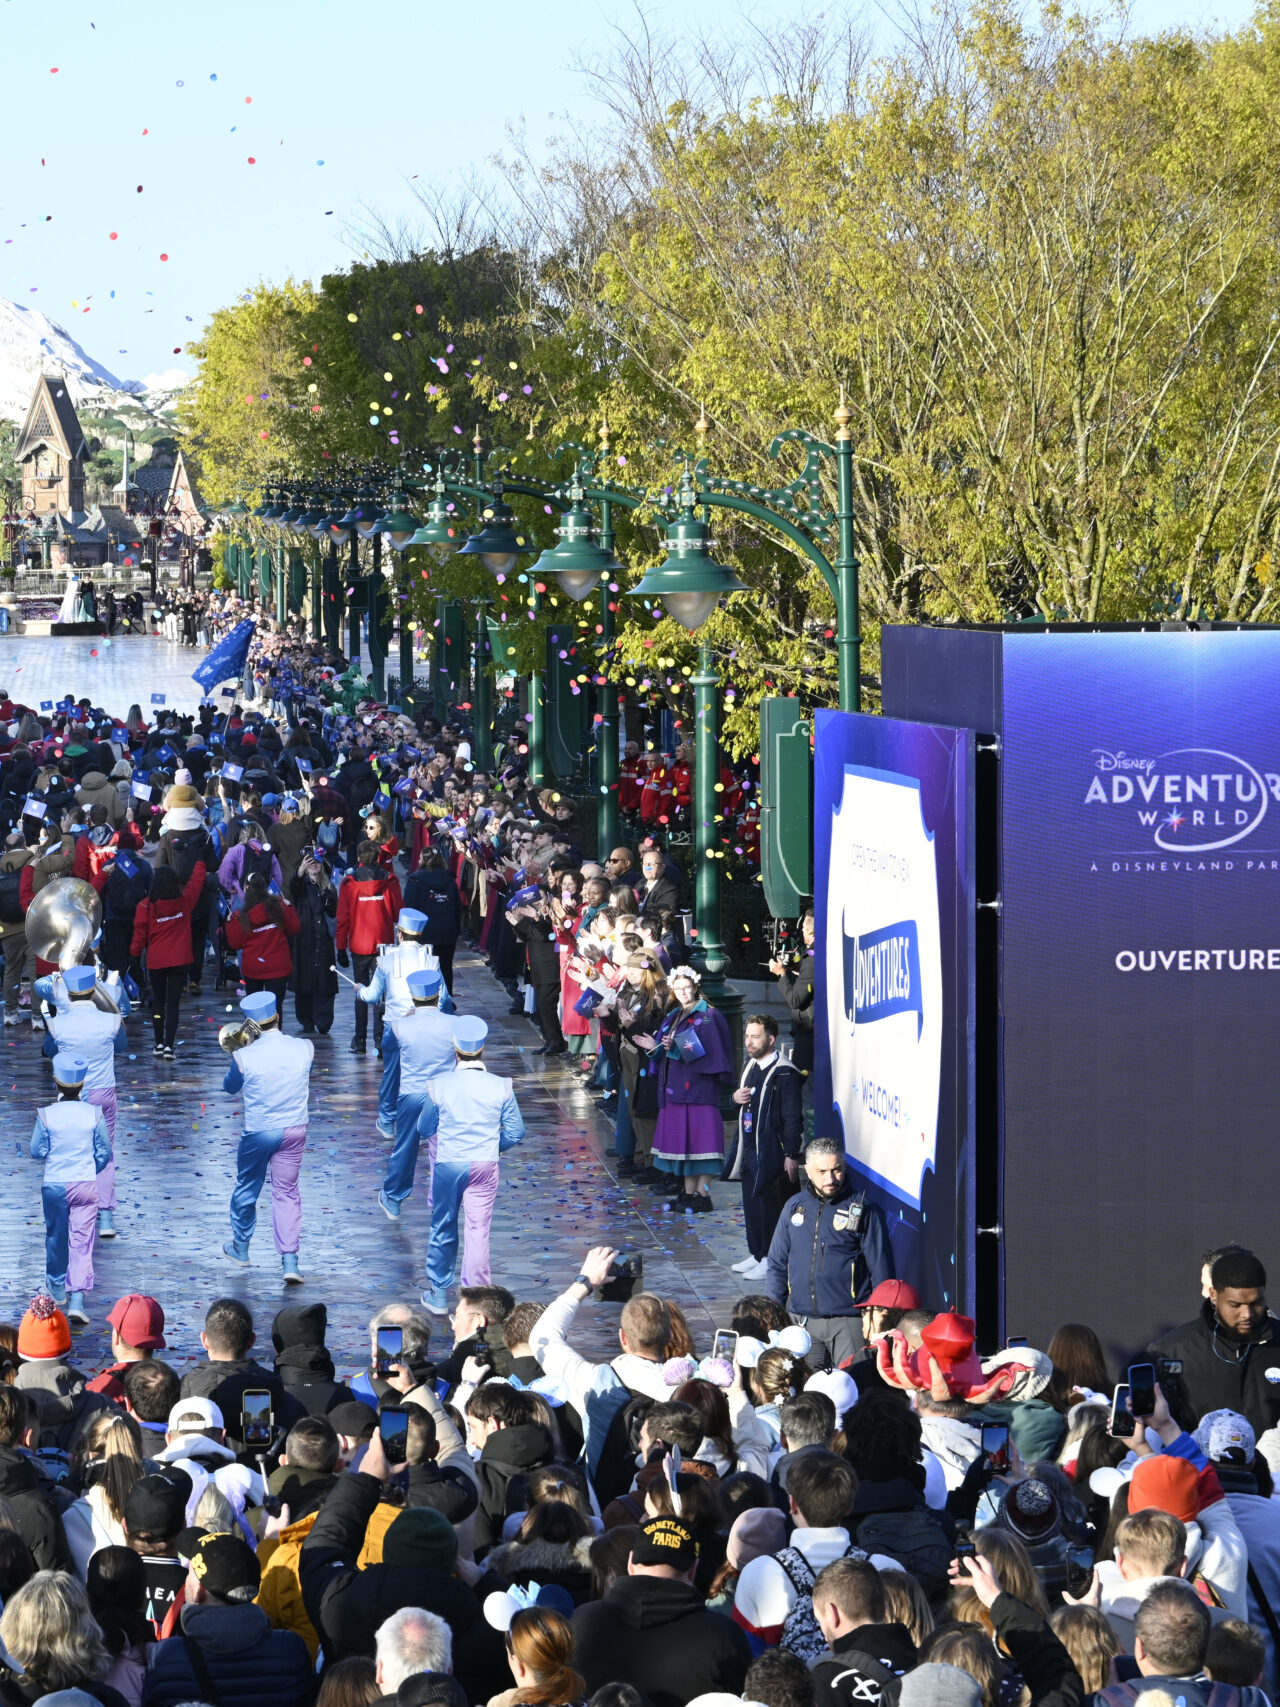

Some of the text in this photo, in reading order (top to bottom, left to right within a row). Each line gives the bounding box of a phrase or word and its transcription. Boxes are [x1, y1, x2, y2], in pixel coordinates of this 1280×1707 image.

[1112, 860, 1234, 872] DISNEYLAND
[1115, 949, 1280, 972] OUVERTURE
[848, 936, 910, 1037] ADVENTURES
[861, 1076, 901, 1129] WELCOME!
[643, 1520, 691, 1541] DISNEYLAND
[652, 1531, 682, 1549] PARIS
